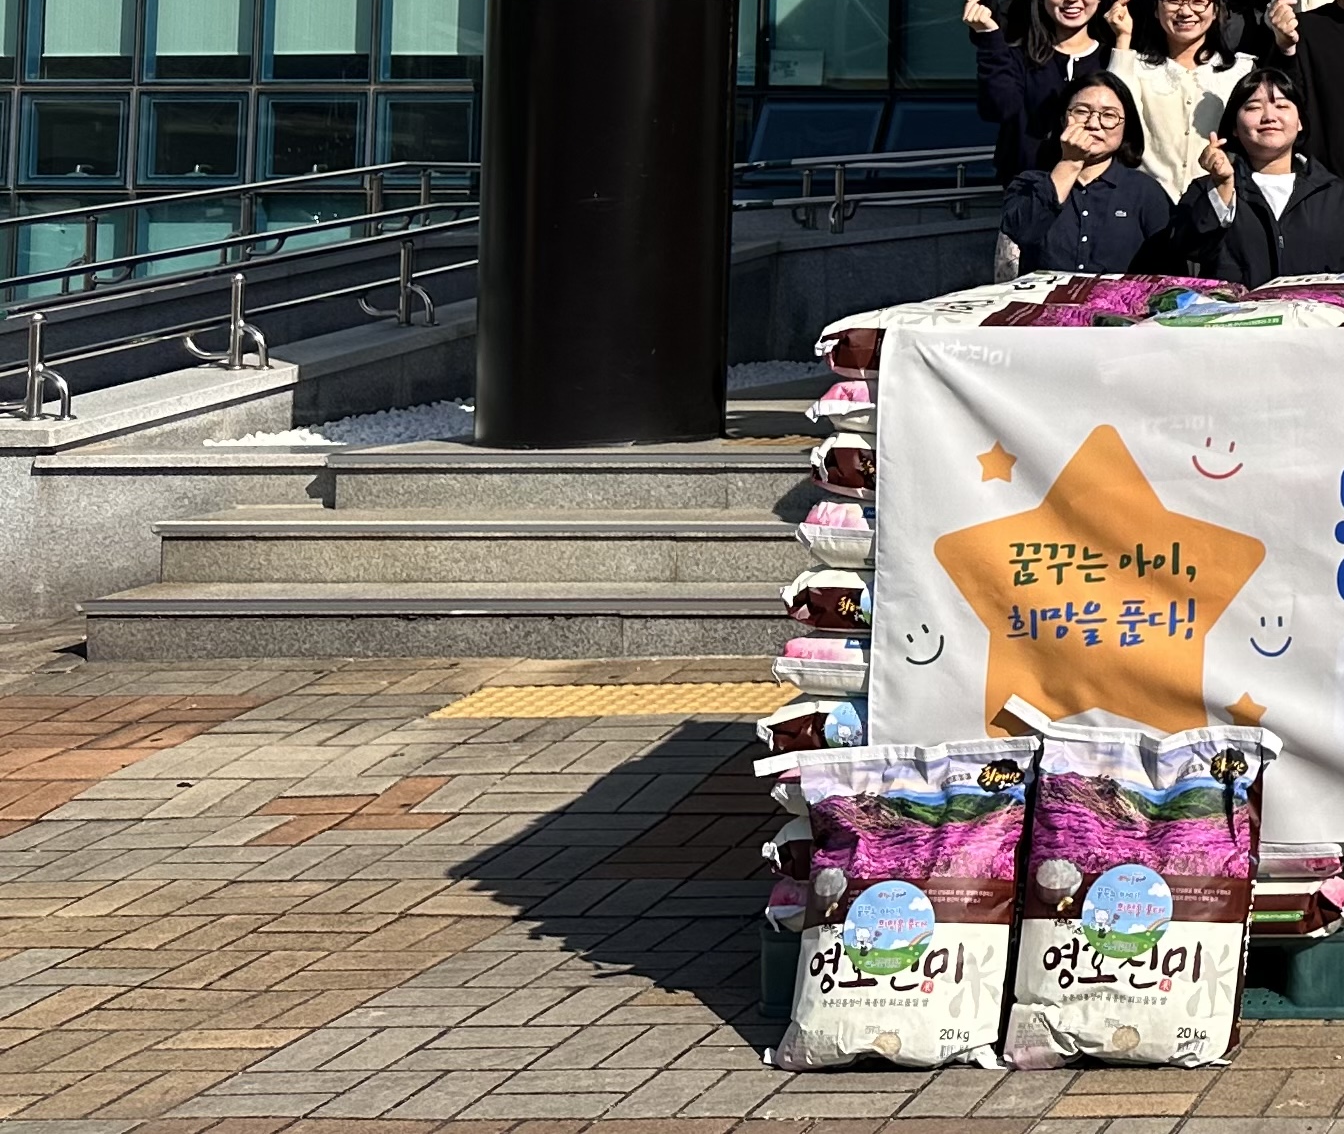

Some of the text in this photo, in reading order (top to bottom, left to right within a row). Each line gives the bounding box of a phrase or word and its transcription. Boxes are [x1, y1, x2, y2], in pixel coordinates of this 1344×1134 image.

[1009, 542, 1196, 586] 꿈꾸는 아이,
[1007, 598, 1196, 646] 희망을 품다!
[939, 1029, 970, 1043] 20 kg
[1177, 1027, 1191, 1039] 20
